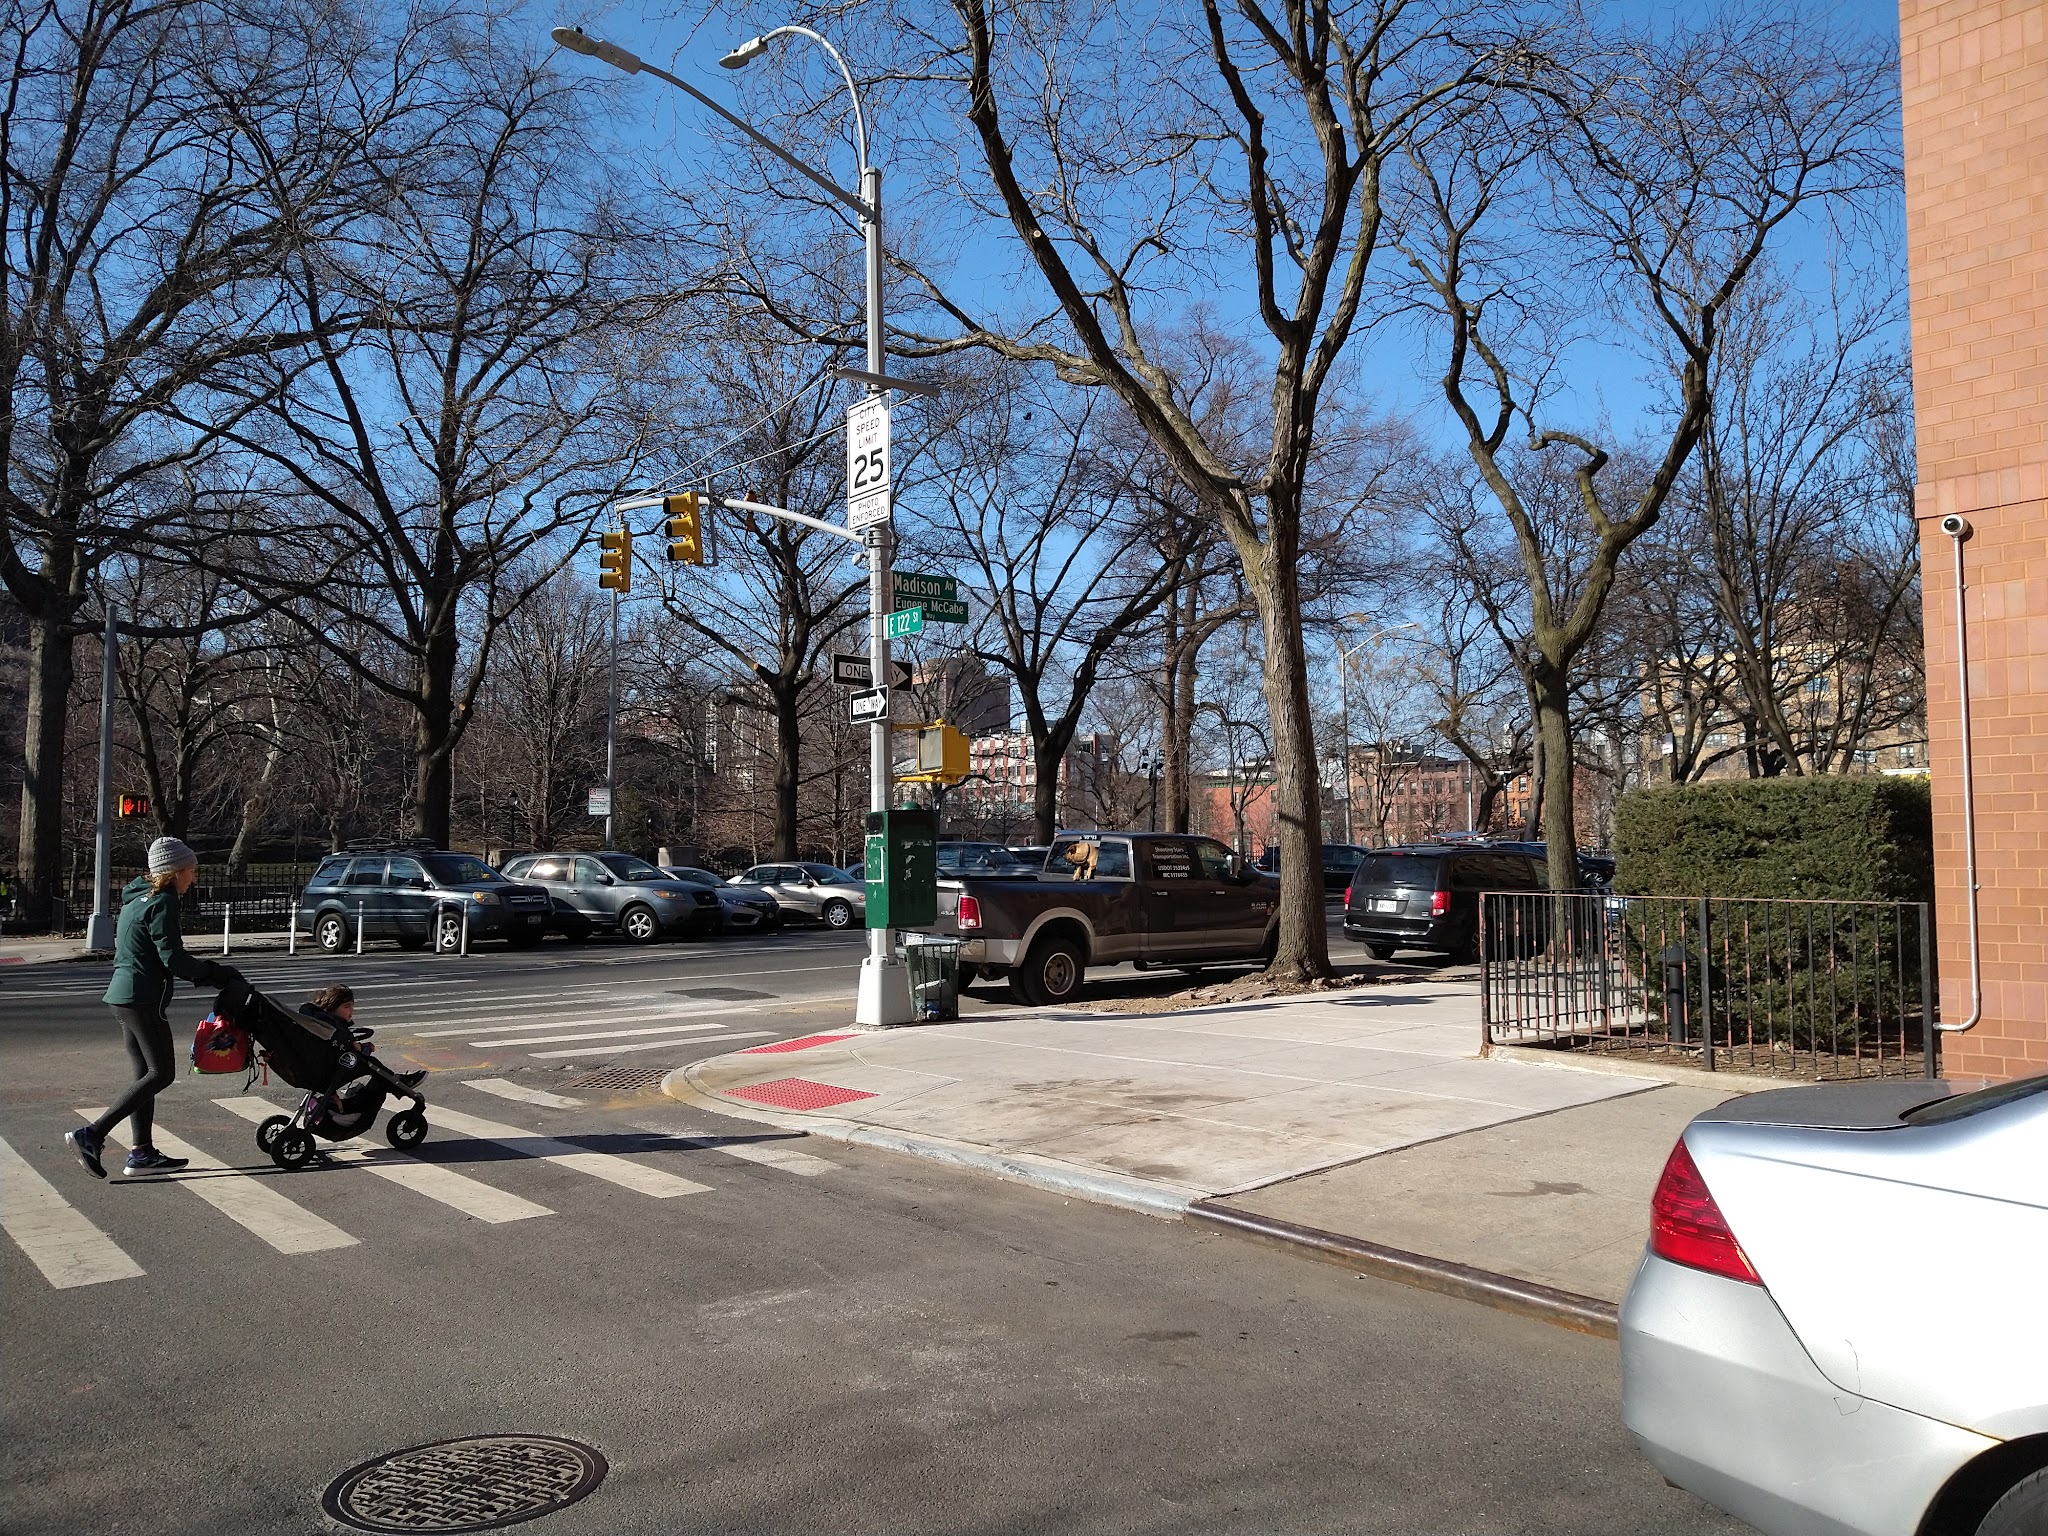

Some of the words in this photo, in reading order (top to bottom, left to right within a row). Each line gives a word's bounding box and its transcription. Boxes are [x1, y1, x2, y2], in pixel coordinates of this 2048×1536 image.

[859, 404, 877, 419] CITY
[856, 417, 880, 435] SPEED
[859, 432, 878, 449] LIMIT
[854, 447, 884, 489] 25
[858, 497, 879, 511] PHOTO
[852, 505, 885, 525] ENFORCED
[894, 574, 941, 596] Madison
[945, 580, 954, 591] Av
[931, 601, 964, 615] McCabe
[889, 617, 895, 635] E
[897, 613, 910, 633] 122
[845, 664, 868, 678] ONE
[856, 700, 867, 712] ONE
